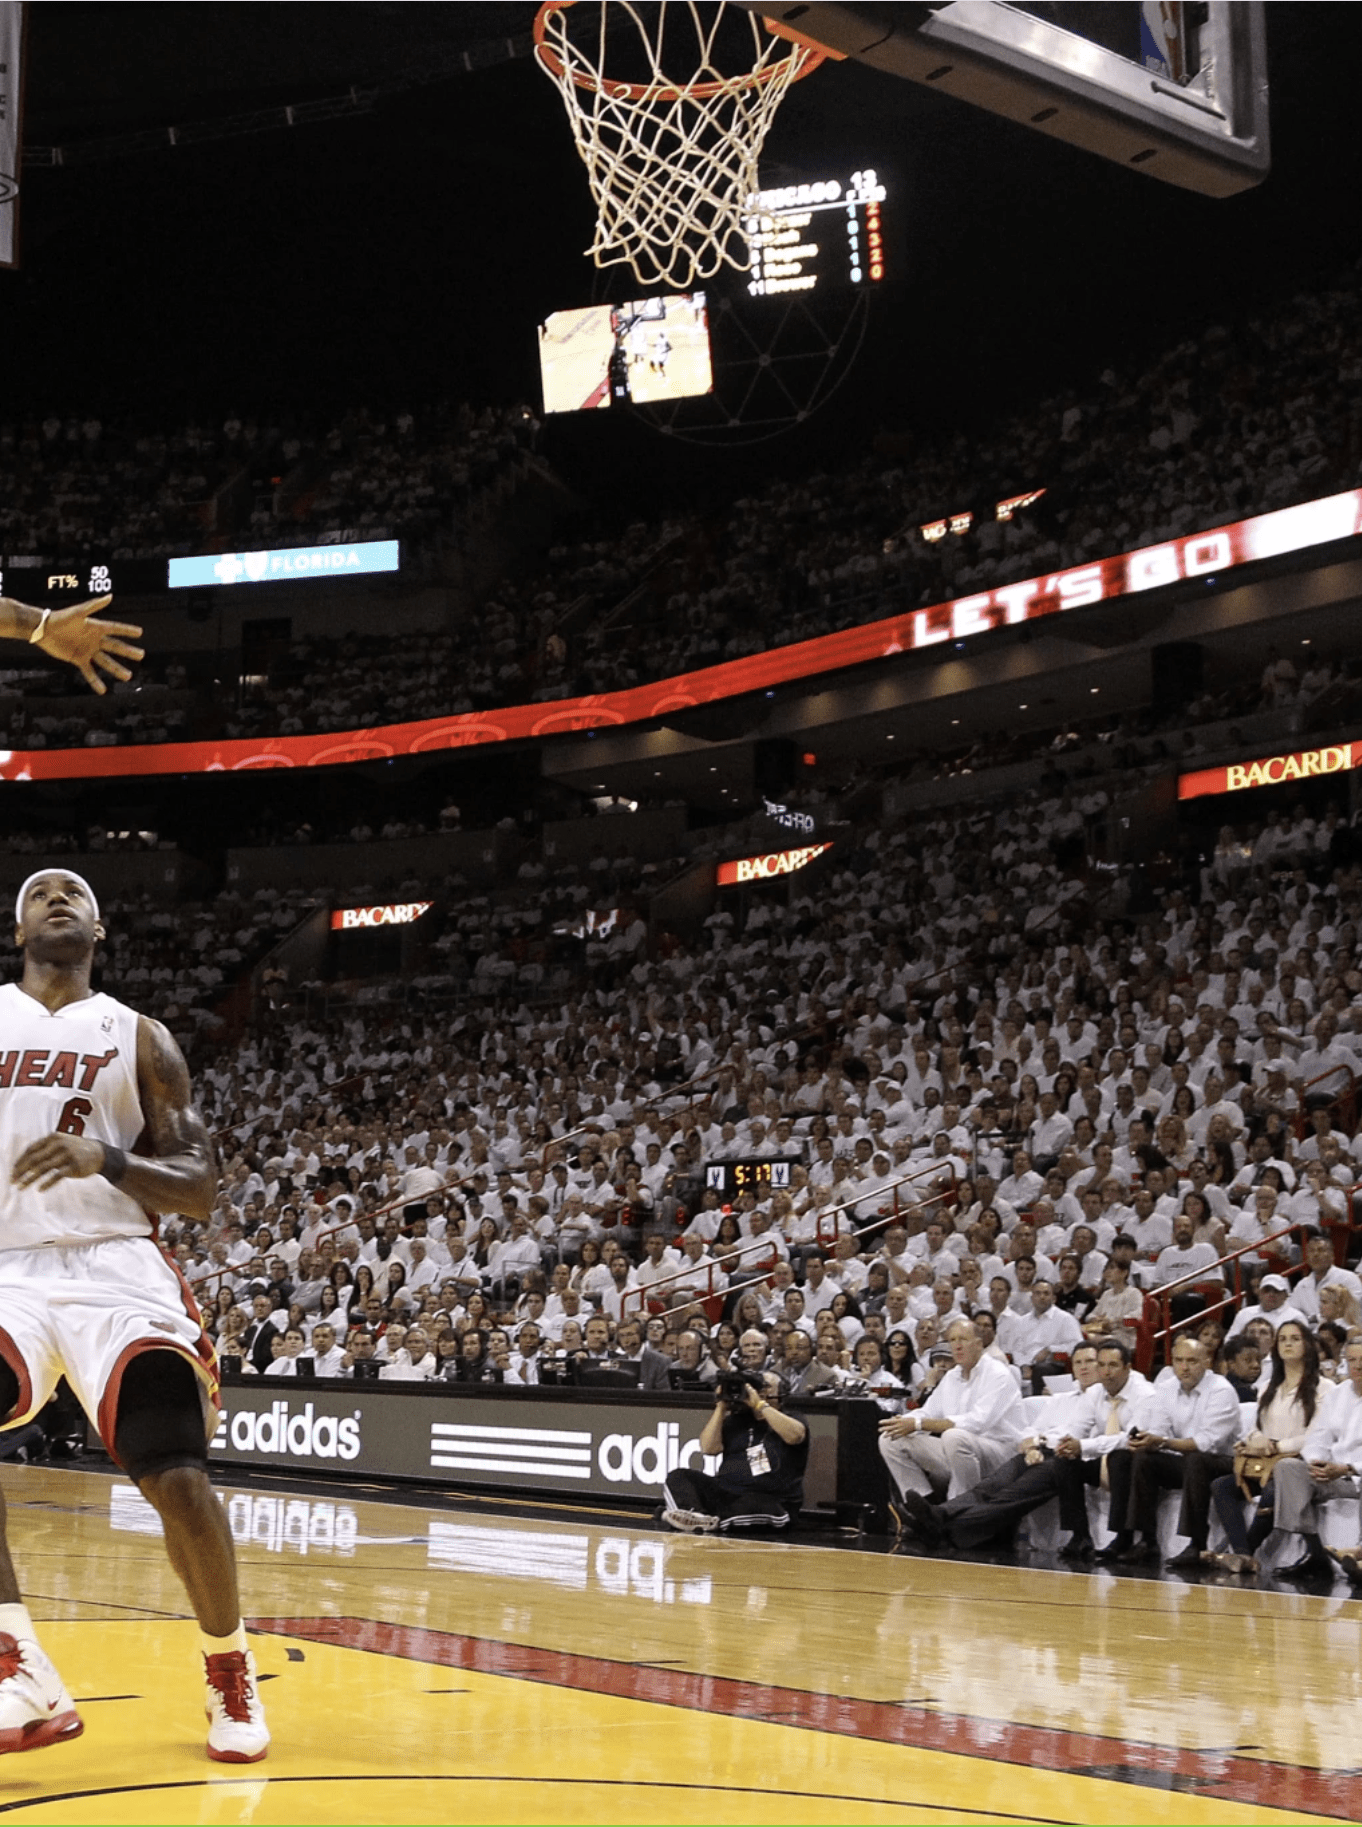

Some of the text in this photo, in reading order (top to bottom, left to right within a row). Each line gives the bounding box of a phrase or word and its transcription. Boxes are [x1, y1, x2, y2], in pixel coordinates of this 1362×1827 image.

[867, 216, 880, 231] 4
[868, 232, 882, 247] 3
[869, 247, 883, 263] 2
[869, 264, 884, 280] 0
[269, 549, 362, 573] FLORIDA
[90, 565, 109, 580] 50
[48, 574, 79, 589] FT%
[88, 578, 112, 593] 100
[911, 532, 1233, 649] LET'S GO
[1226, 744, 1352, 792] BACARDI
[56, 1096, 93, 1137] 6
[734, 1163, 771, 1186] 5:17
[230, 1401, 362, 1460] adidas
